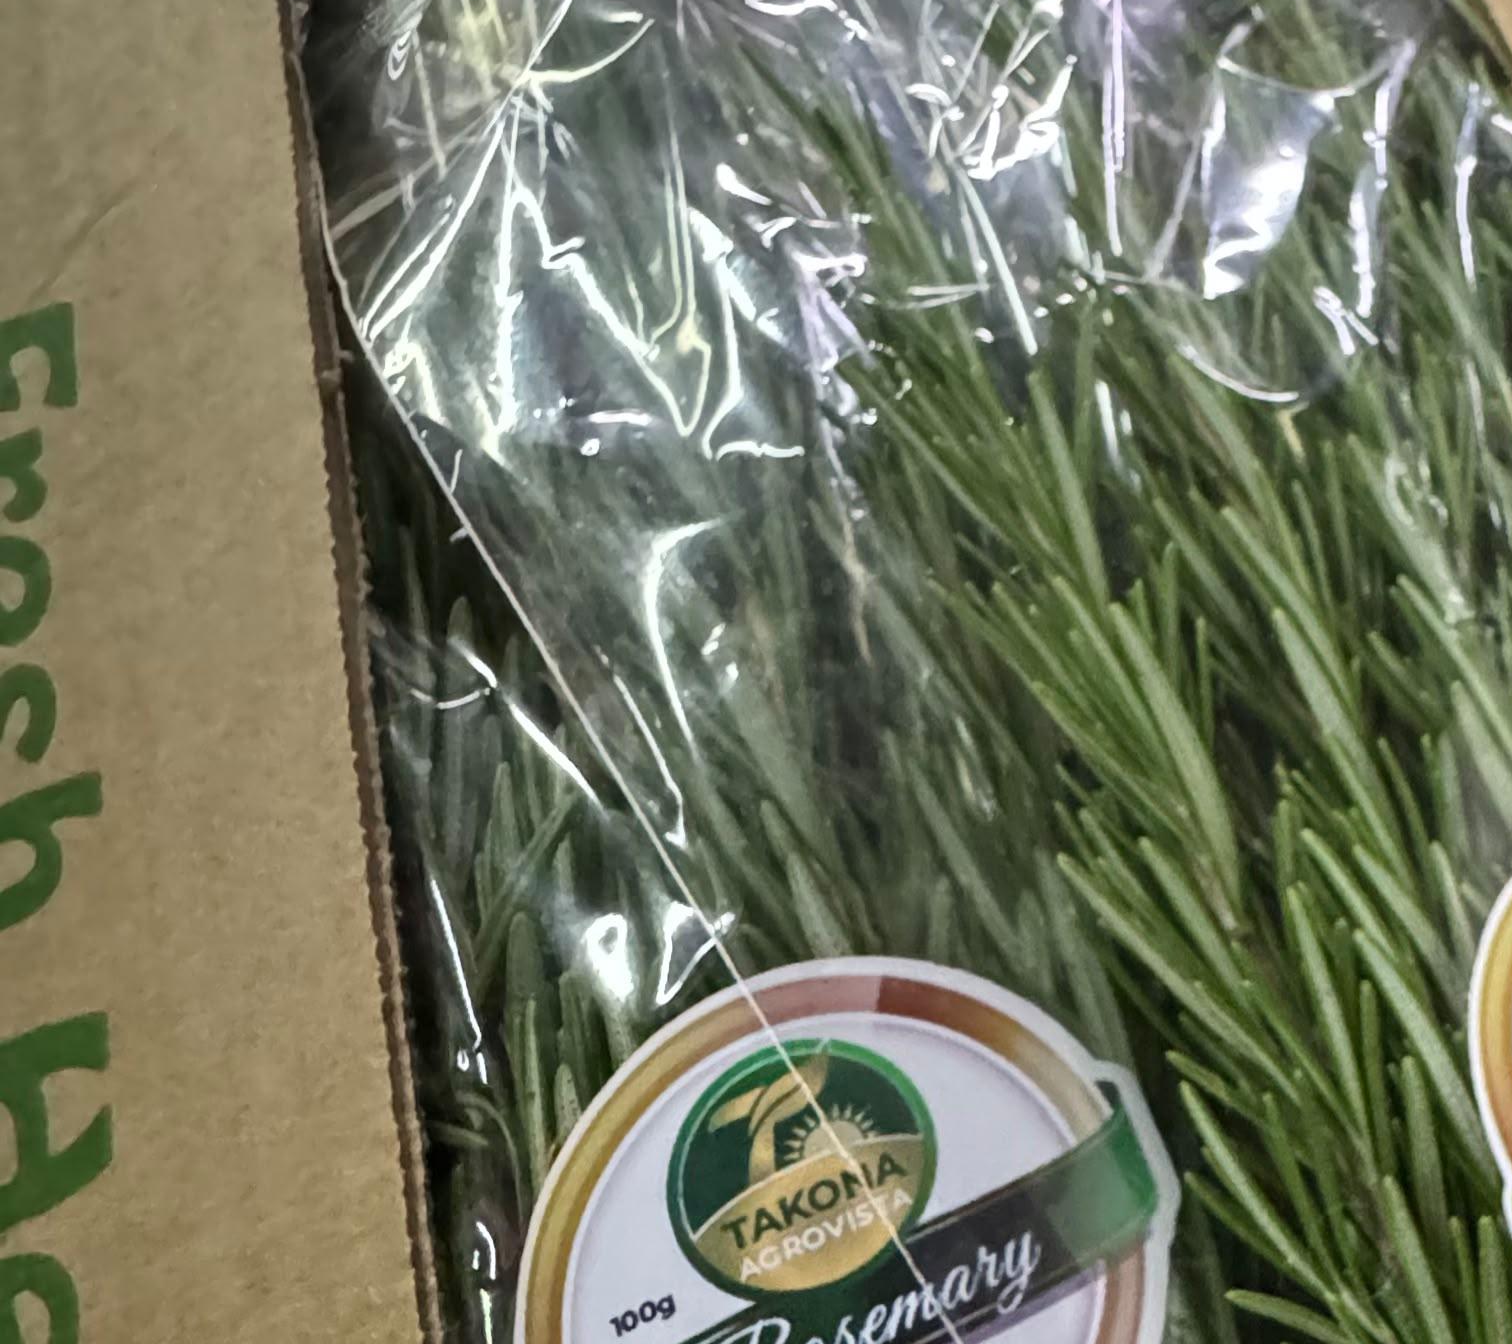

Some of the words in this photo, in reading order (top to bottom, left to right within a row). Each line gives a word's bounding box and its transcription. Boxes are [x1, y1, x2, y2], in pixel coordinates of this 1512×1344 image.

[720, 1150, 909, 1252] TAKONA
[739, 1187, 914, 1282] AGROVISTA
[610, 1293, 678, 1338] 100g
